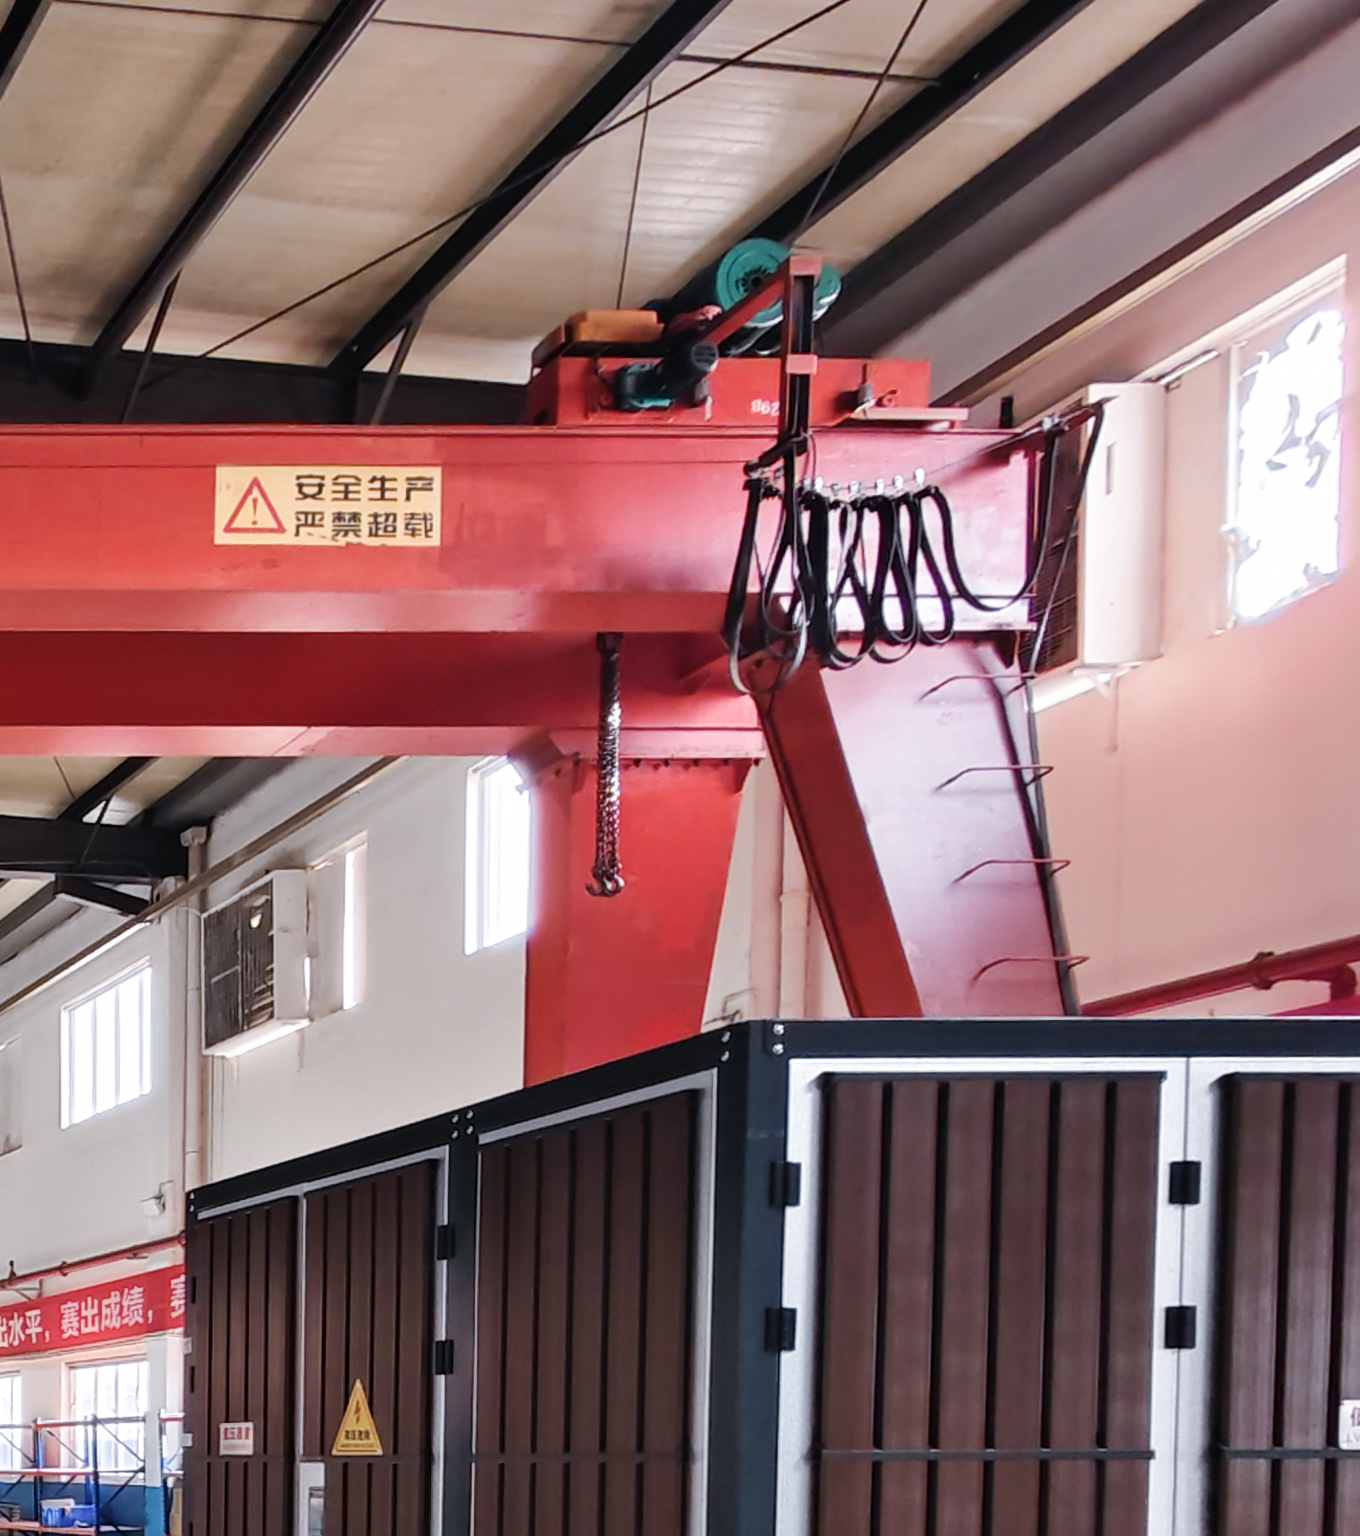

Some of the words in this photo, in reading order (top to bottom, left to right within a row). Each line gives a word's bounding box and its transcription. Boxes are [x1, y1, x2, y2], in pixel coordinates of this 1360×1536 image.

[295, 474, 434, 502] 安全生产
[294, 510, 434, 539] 严禁超载
